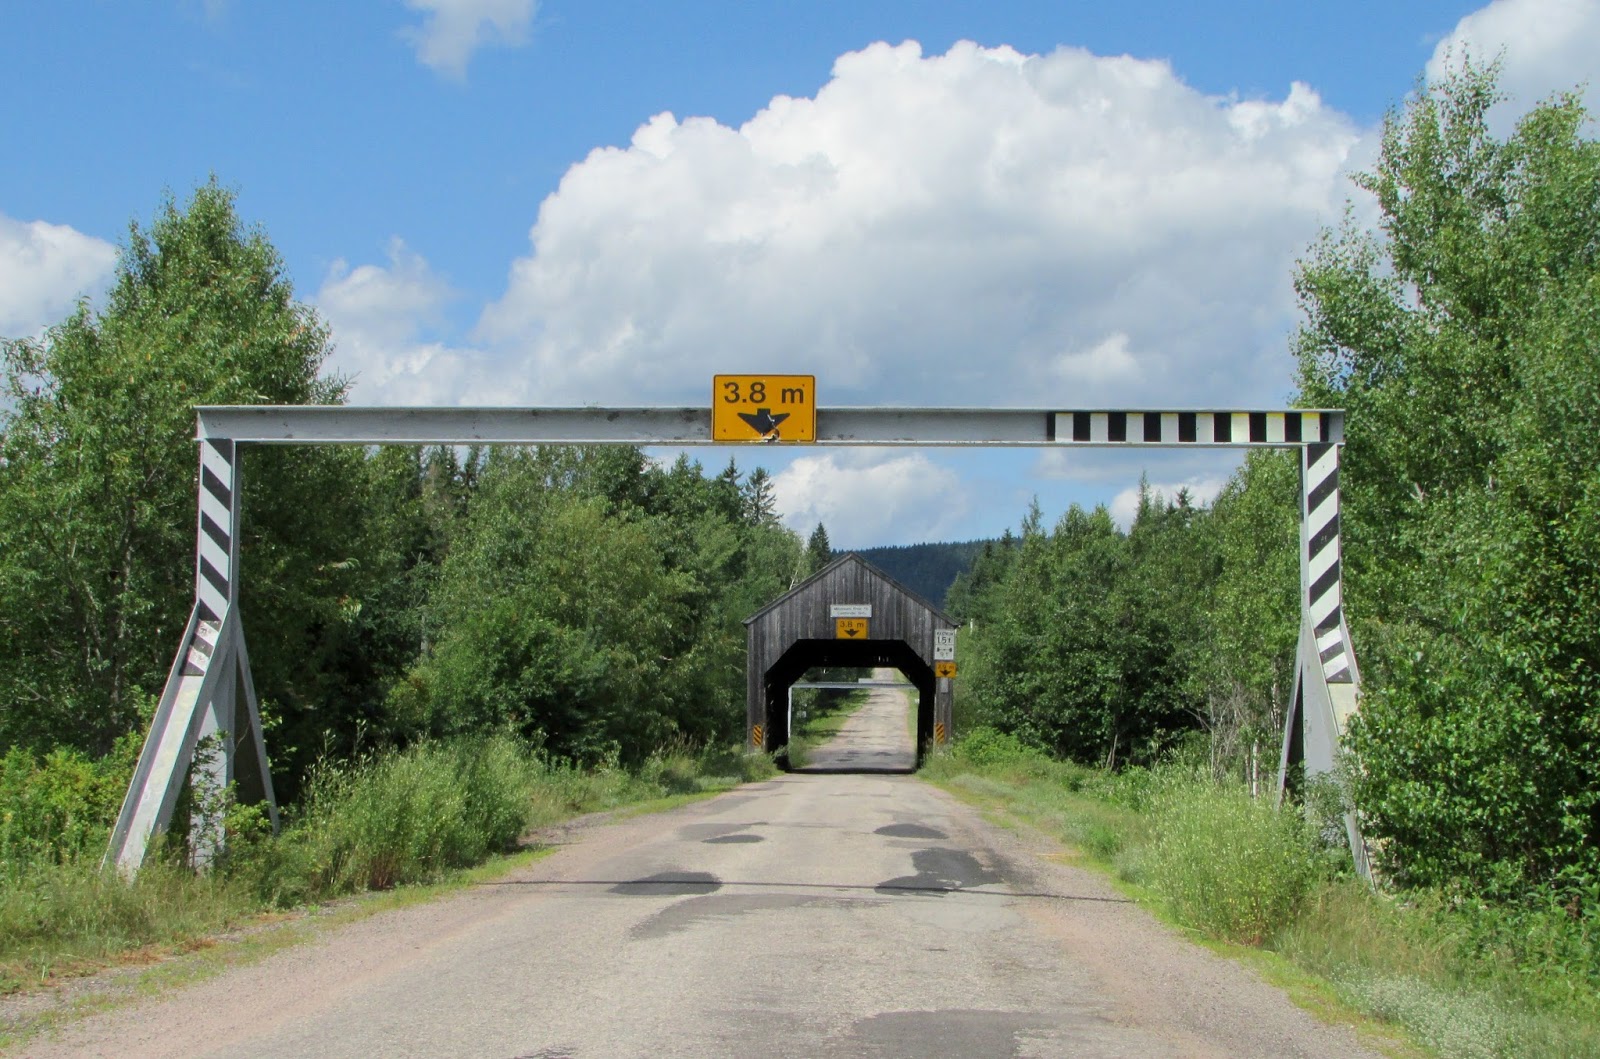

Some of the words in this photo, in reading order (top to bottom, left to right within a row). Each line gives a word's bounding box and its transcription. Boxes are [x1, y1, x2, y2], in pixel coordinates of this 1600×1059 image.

[724, 382, 766, 403] 3.8
[781, 388, 804, 404] m
[840, 620, 853, 628] 3.8
